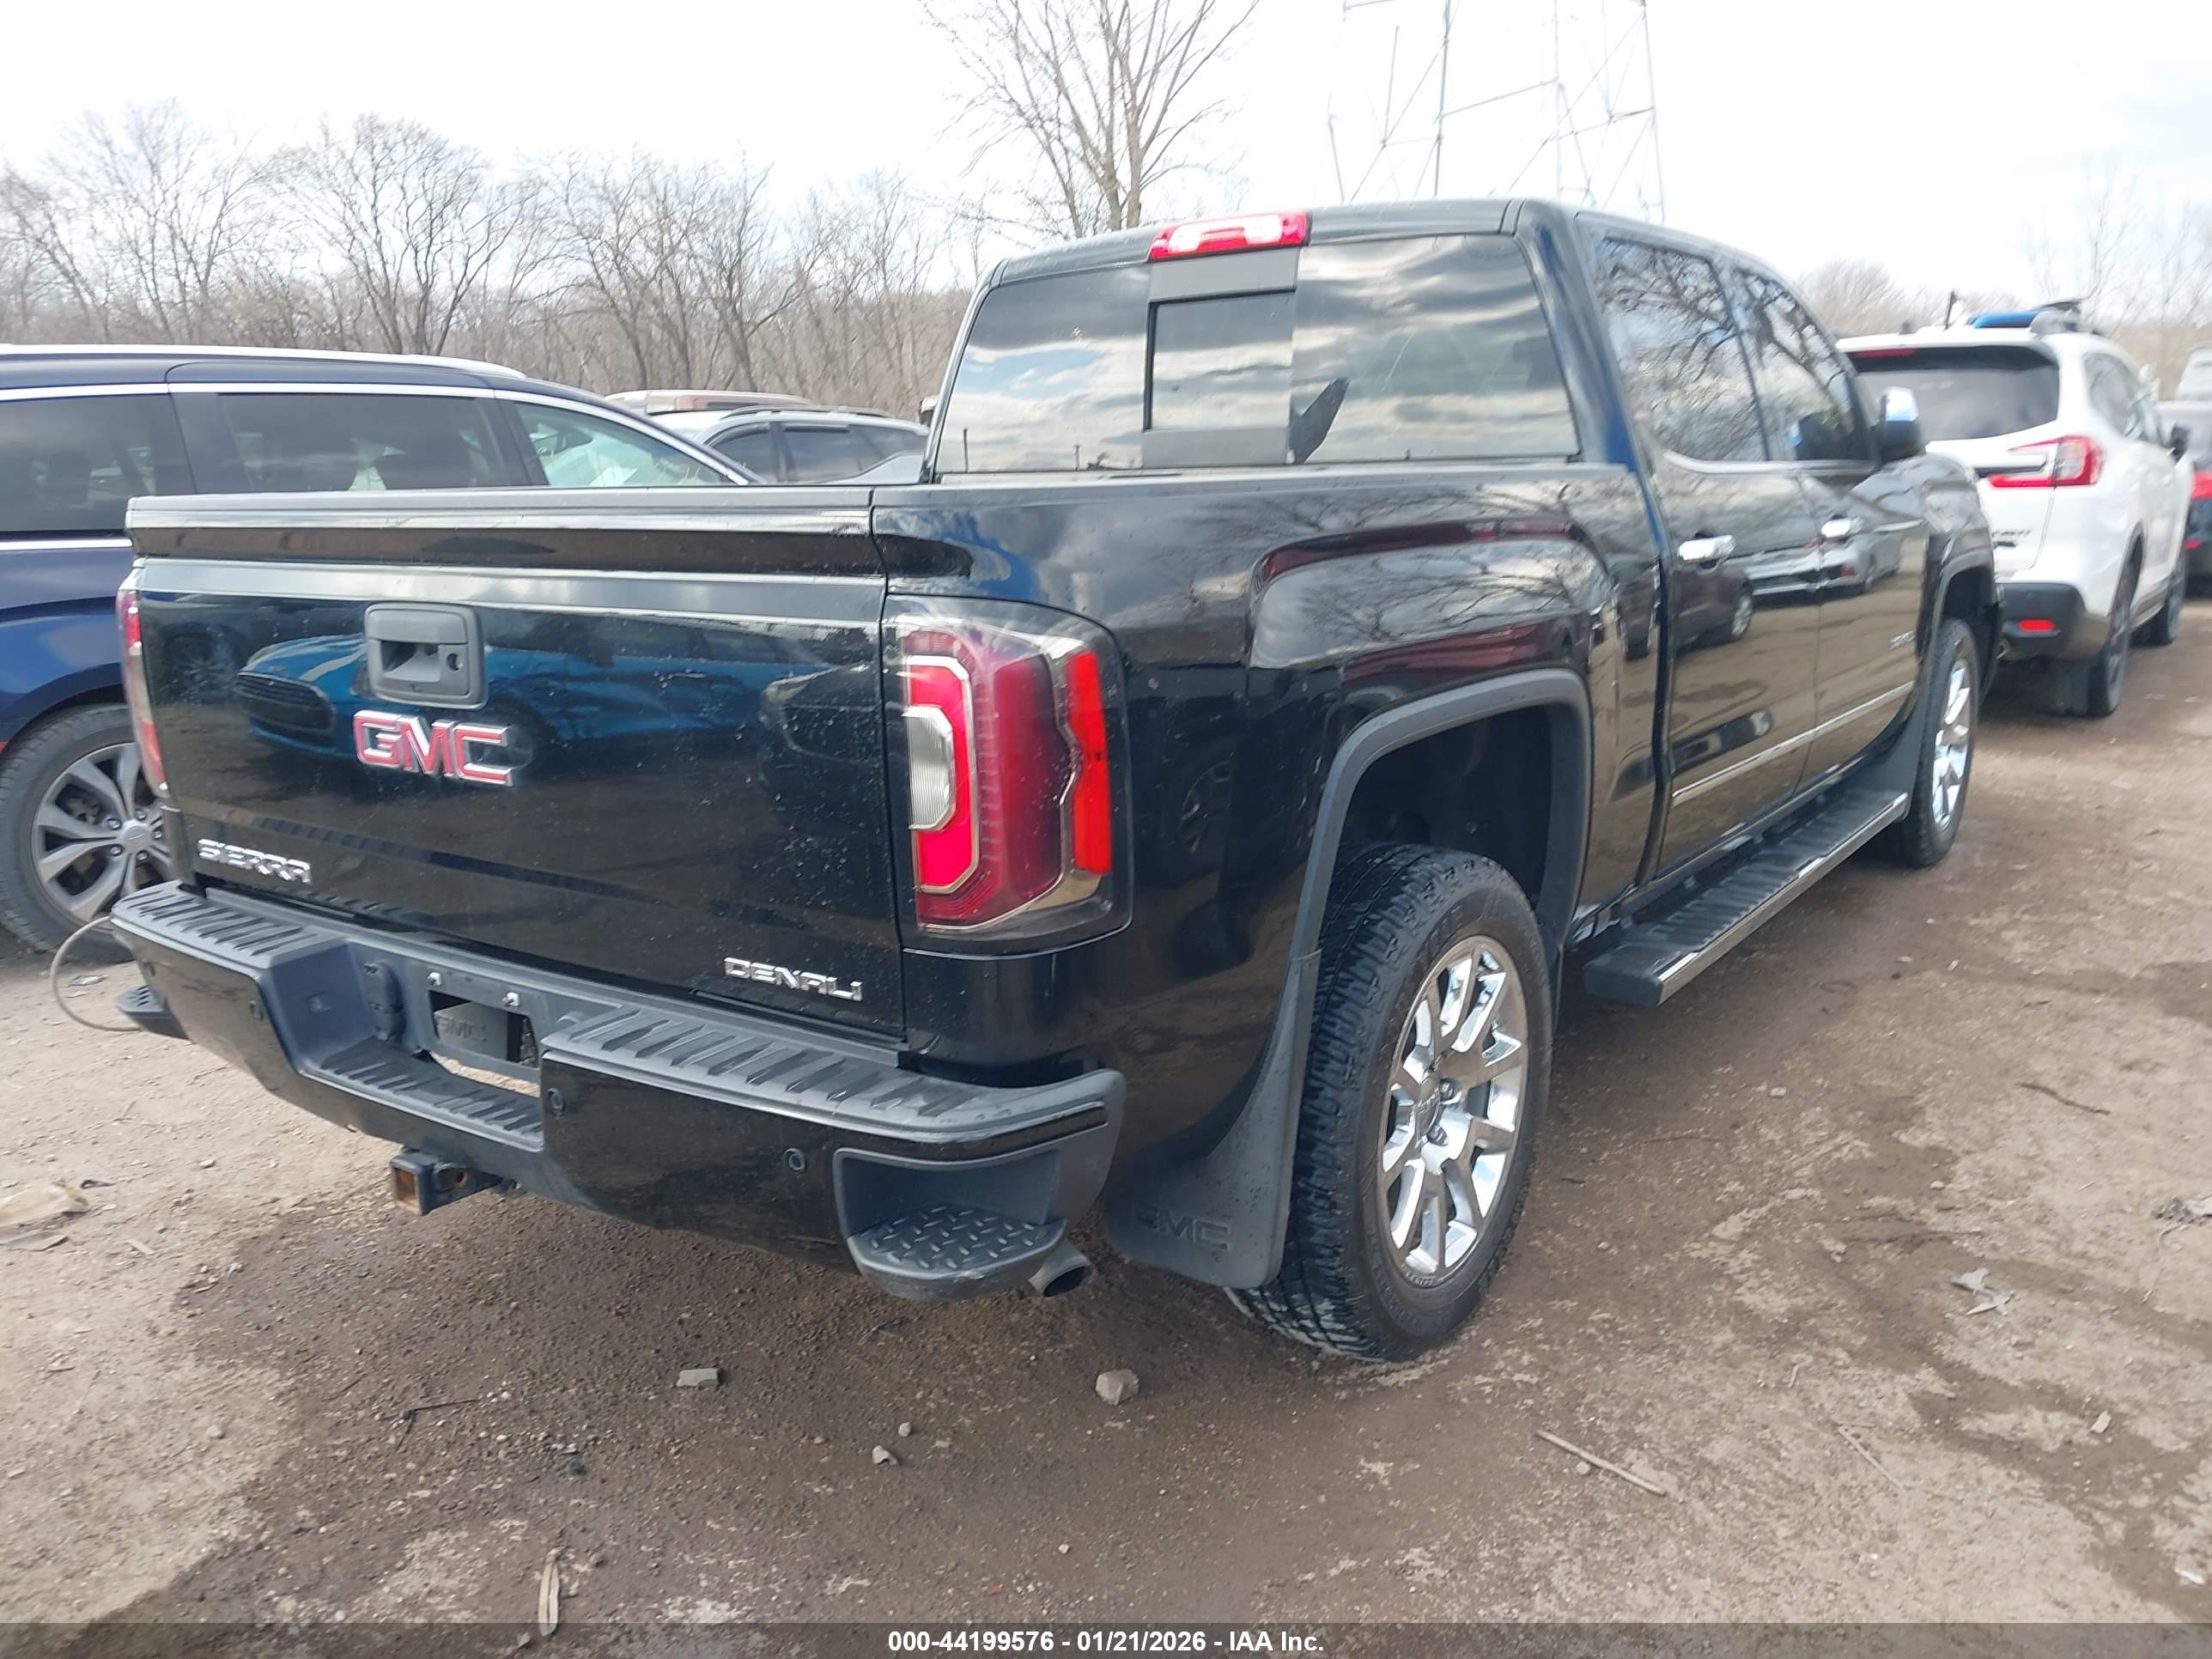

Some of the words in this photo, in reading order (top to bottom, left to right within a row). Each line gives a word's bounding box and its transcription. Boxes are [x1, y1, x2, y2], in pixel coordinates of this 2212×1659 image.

[353, 709, 514, 787] GMC
[197, 838, 312, 884] SIERRA
[723, 957, 864, 1002] DENALI
